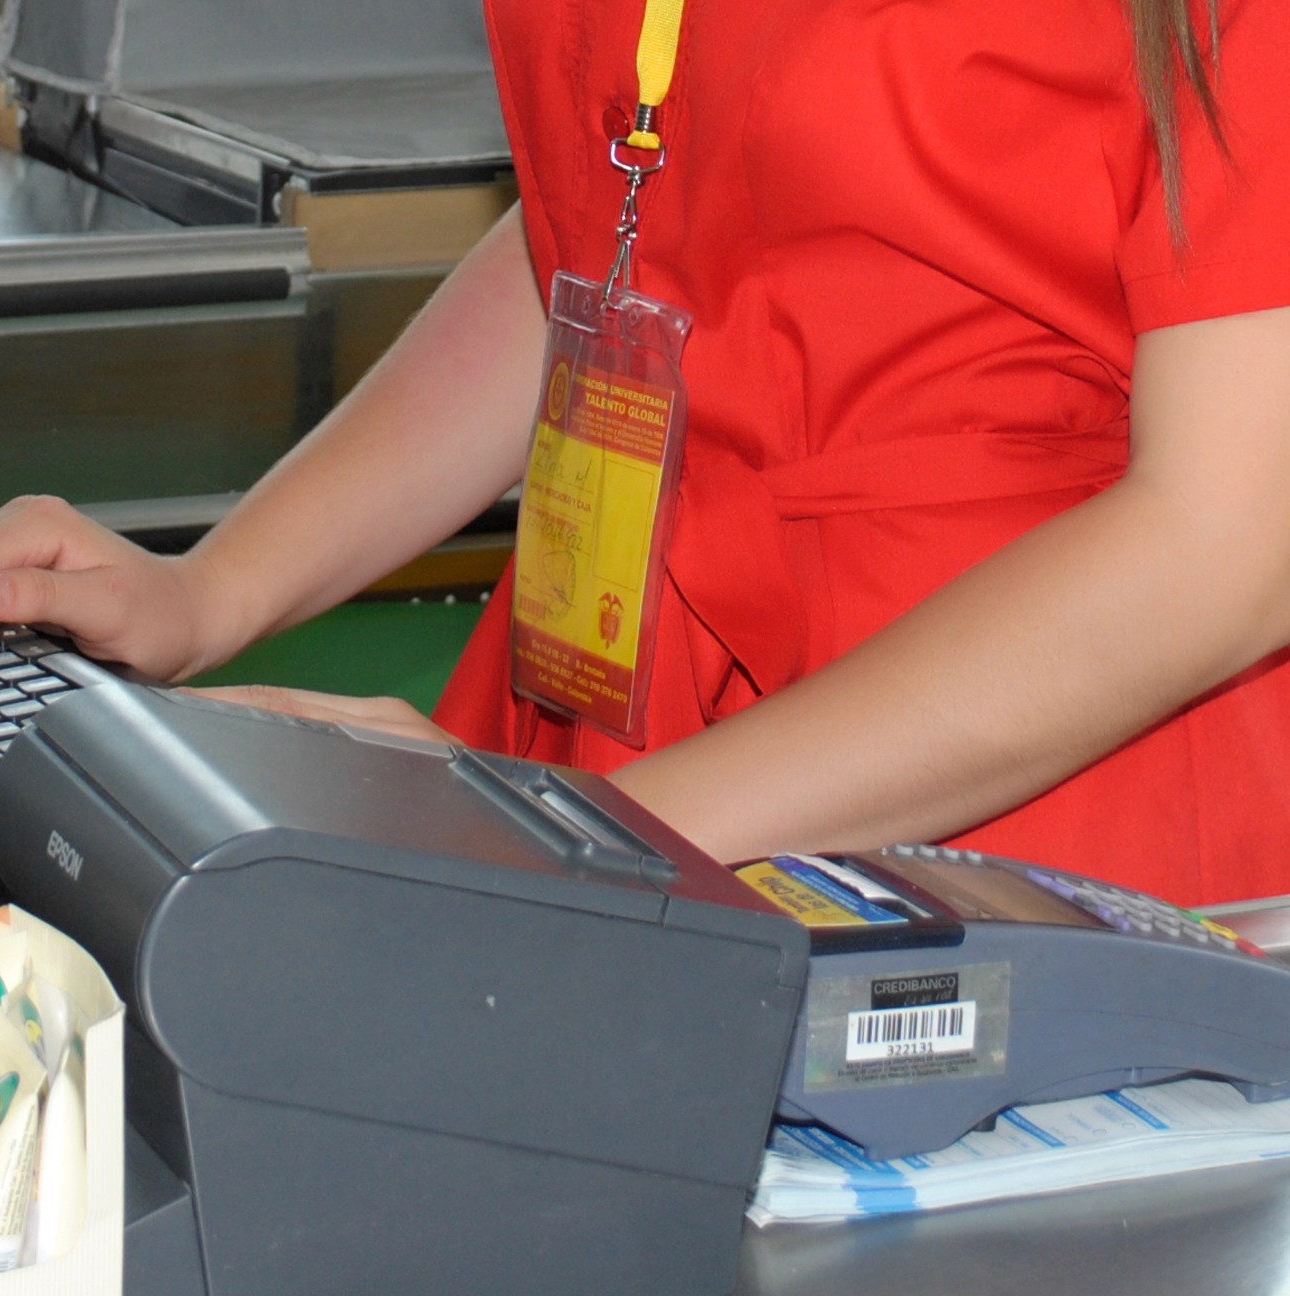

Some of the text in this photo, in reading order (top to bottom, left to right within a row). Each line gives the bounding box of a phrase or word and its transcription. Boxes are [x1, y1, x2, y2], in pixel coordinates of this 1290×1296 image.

[585, 391, 627, 416] TALENTO
[628, 404, 667, 428] GLOBAL
[47, 829, 84, 881] EPSON
[873, 975, 957, 995] CREDIBANCO
[886, 1041, 934, 1058] 322131
